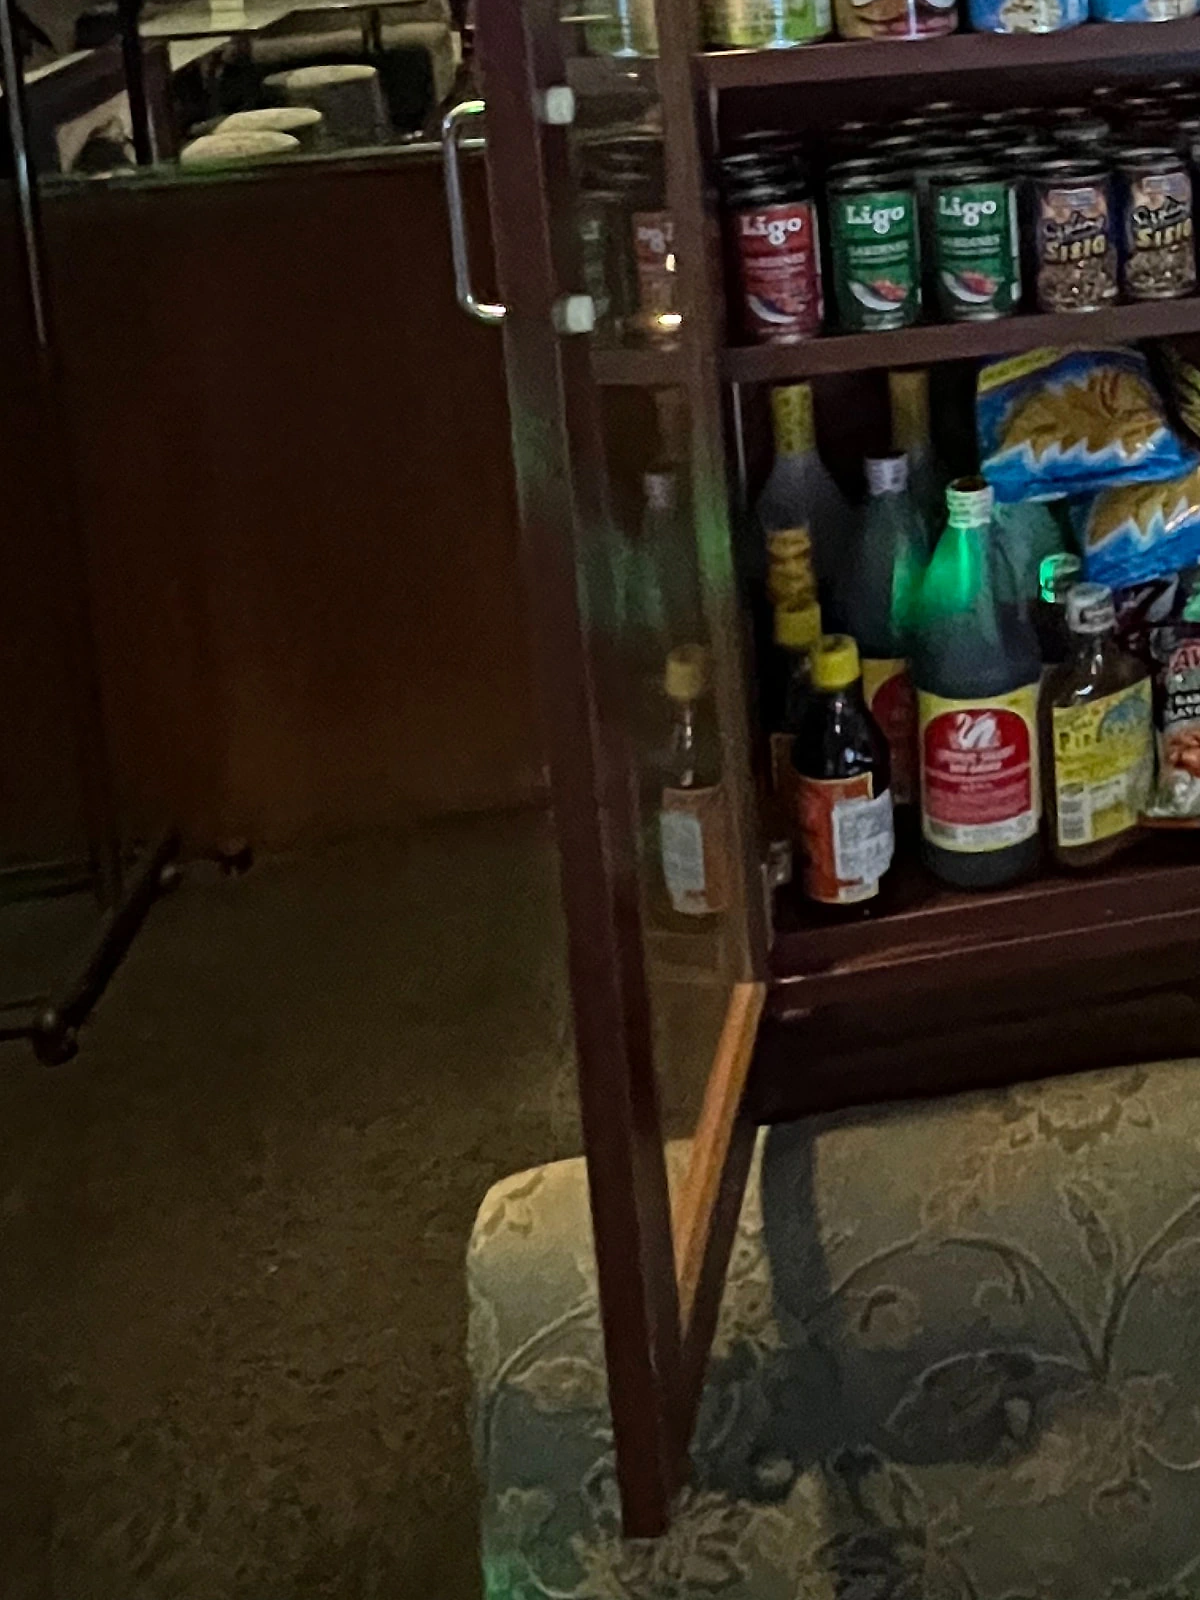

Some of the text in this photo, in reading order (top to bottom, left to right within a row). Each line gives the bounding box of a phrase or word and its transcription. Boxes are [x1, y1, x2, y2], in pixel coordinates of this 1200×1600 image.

[846, 205, 905, 235] Ligo
[940, 195, 997, 227] Ligo
[742, 215, 802, 246] Ligo
